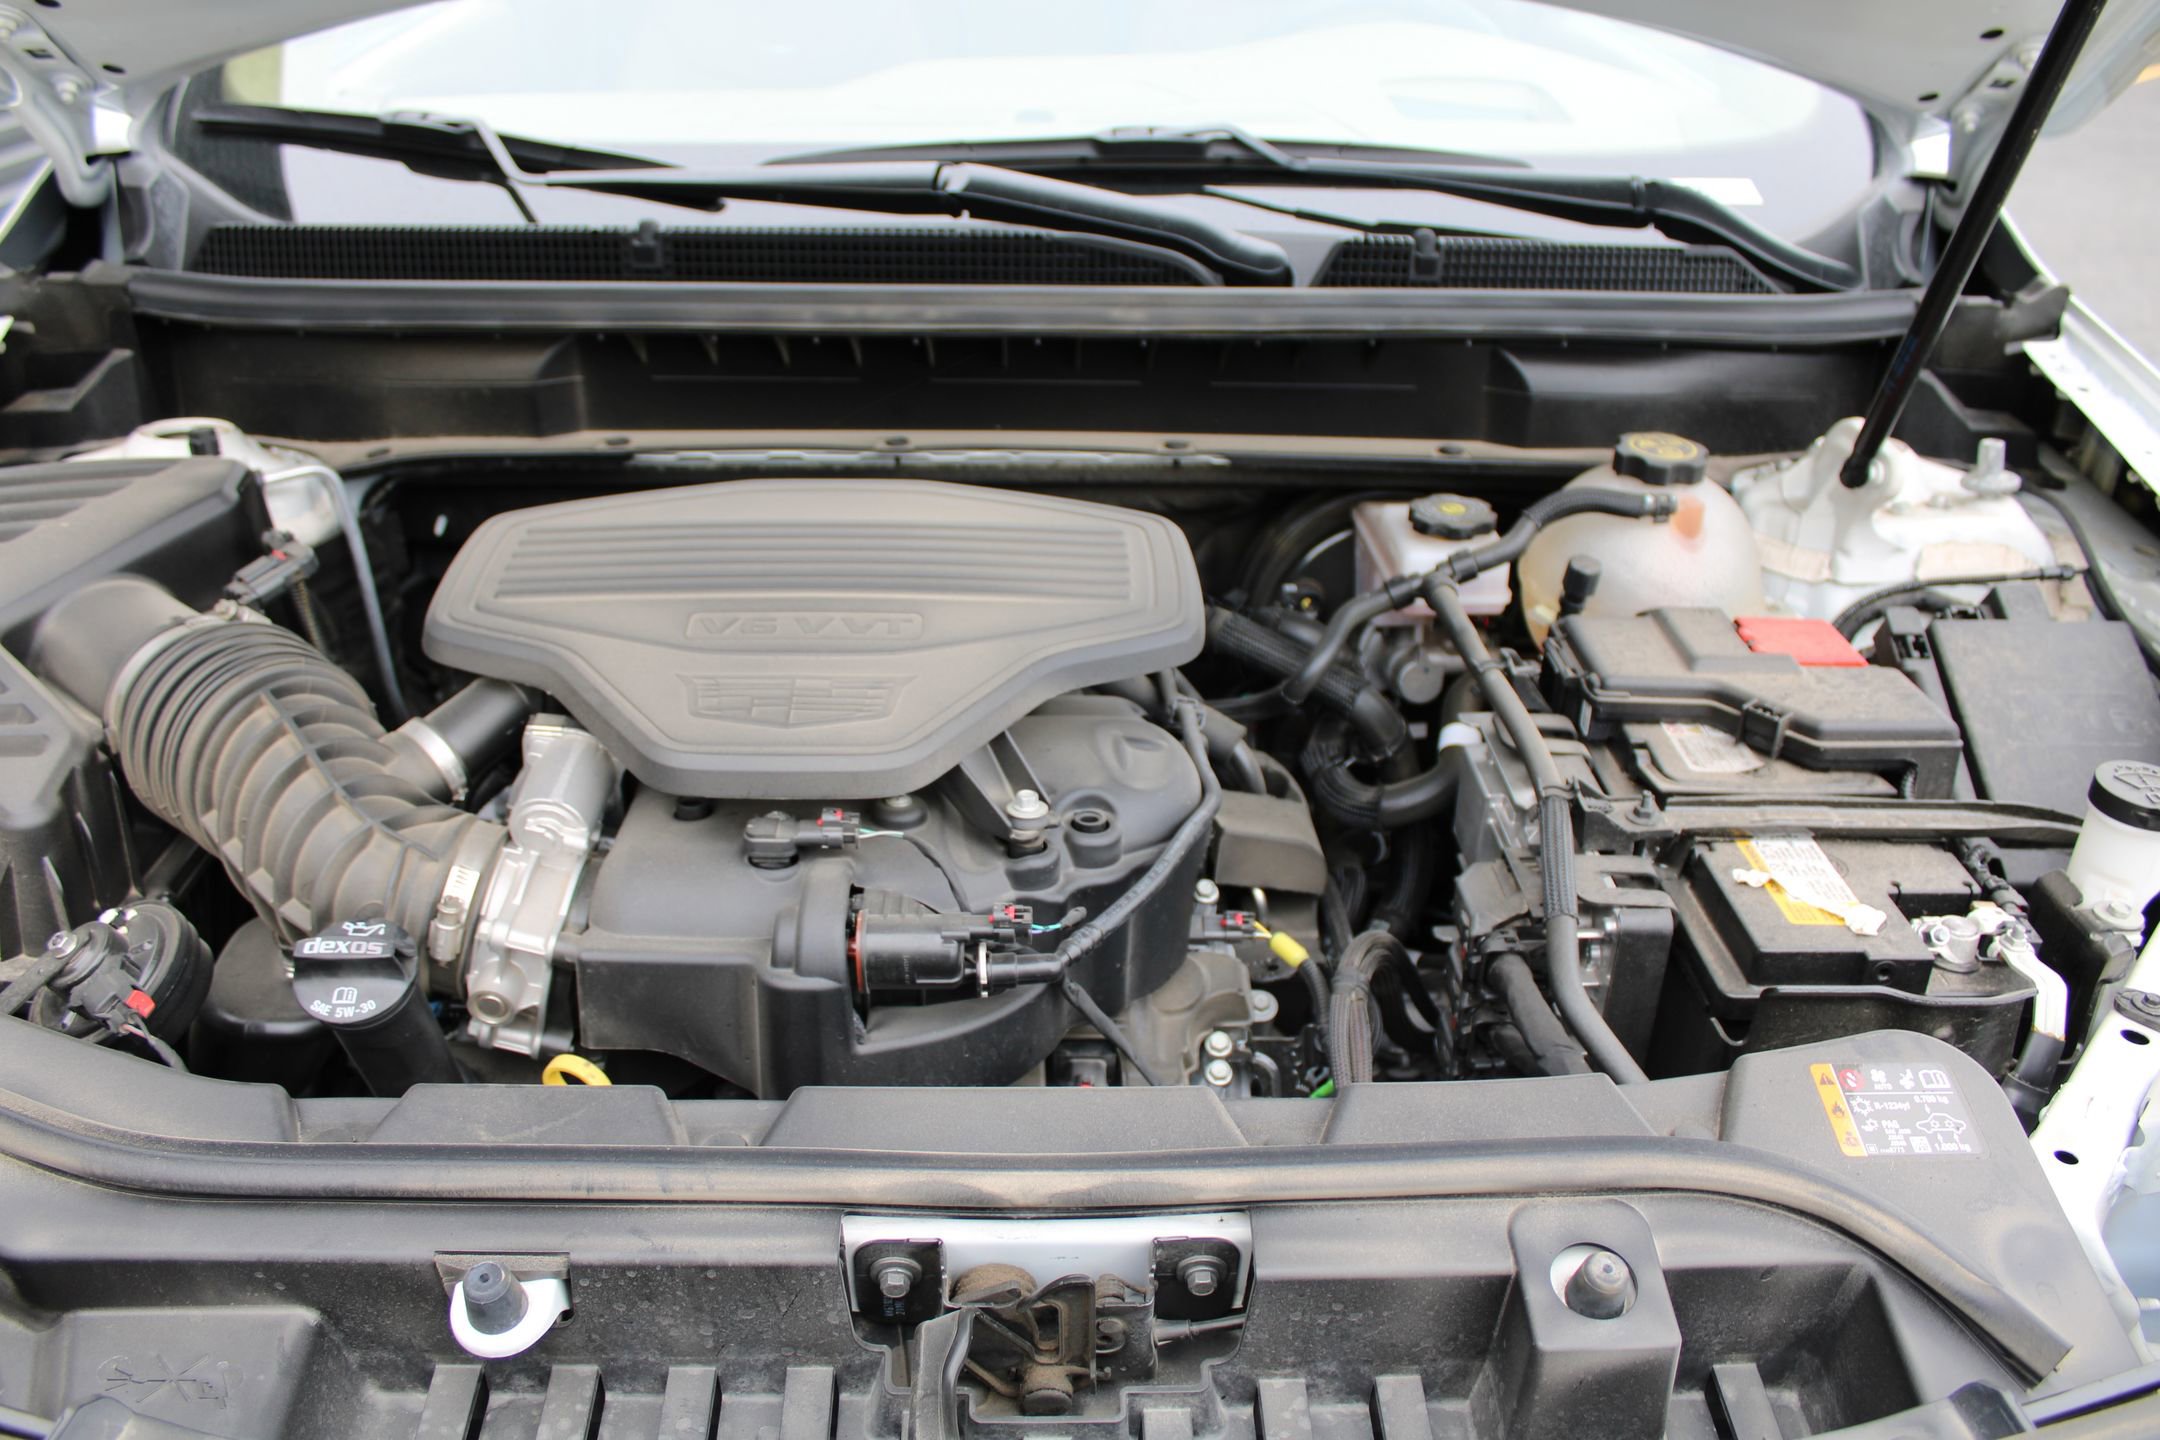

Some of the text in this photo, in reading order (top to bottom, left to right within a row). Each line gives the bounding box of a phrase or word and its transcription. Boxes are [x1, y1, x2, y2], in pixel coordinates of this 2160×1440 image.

[699, 616, 914, 635] V6 VVT
[303, 937, 388, 955] dexos
[310, 999, 377, 1018] SAE 5W-30
[1881, 1119, 1900, 1129] PAG
